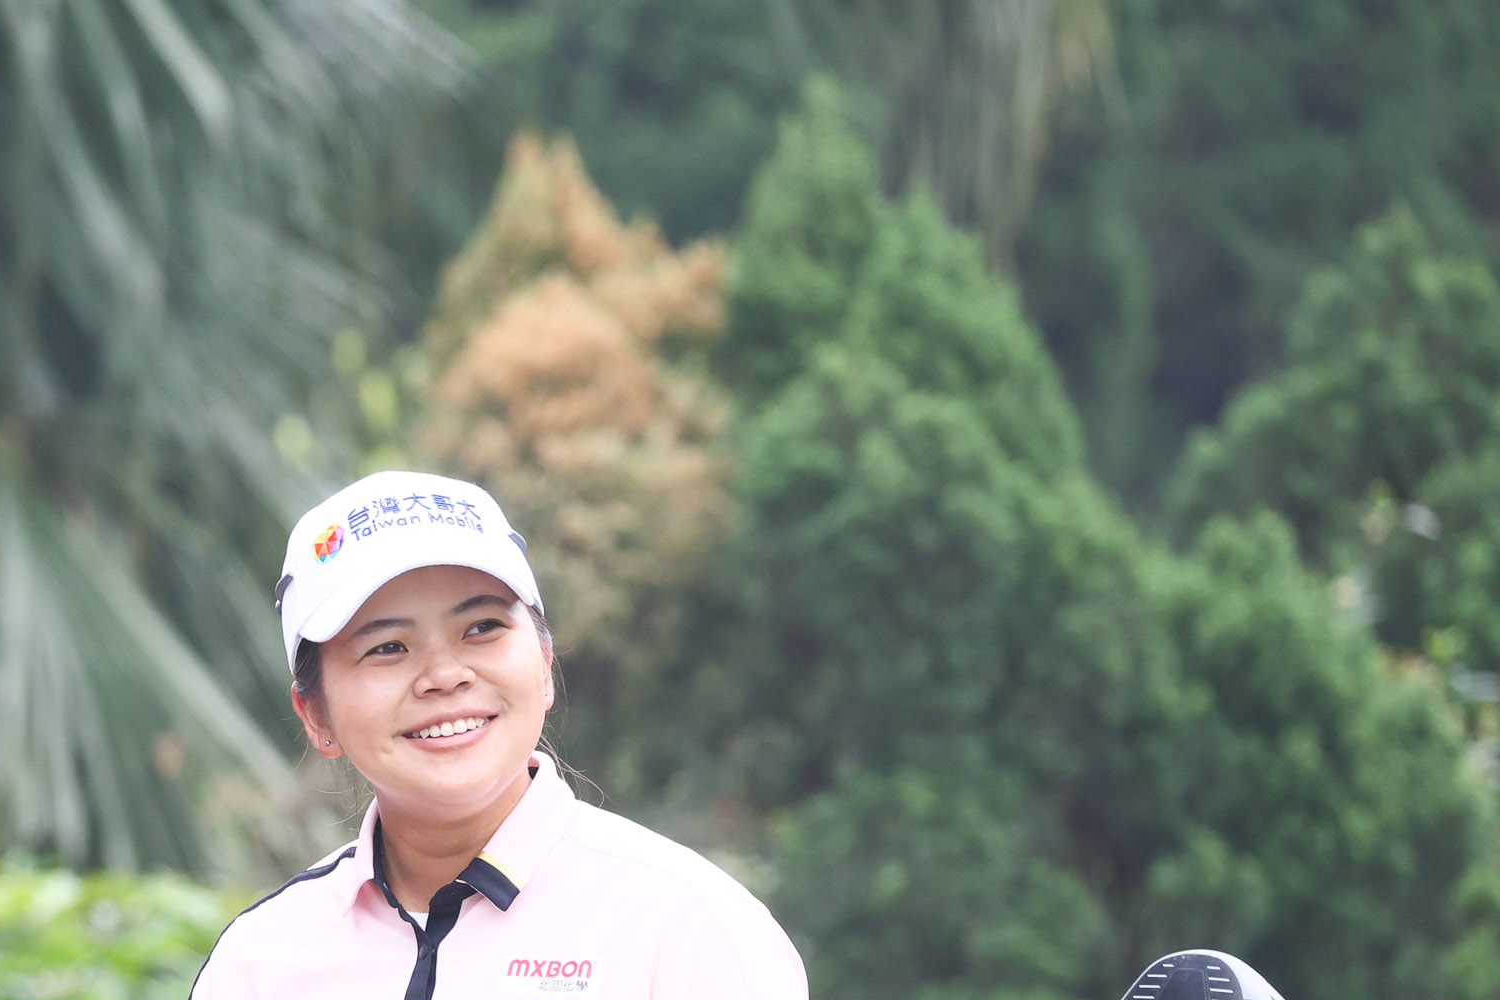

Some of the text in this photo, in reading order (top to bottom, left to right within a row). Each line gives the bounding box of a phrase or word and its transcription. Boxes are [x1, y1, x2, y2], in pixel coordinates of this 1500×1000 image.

[348, 493, 481, 529] 台灣大哥大
[351, 512, 484, 541] Taiwan Mobile
